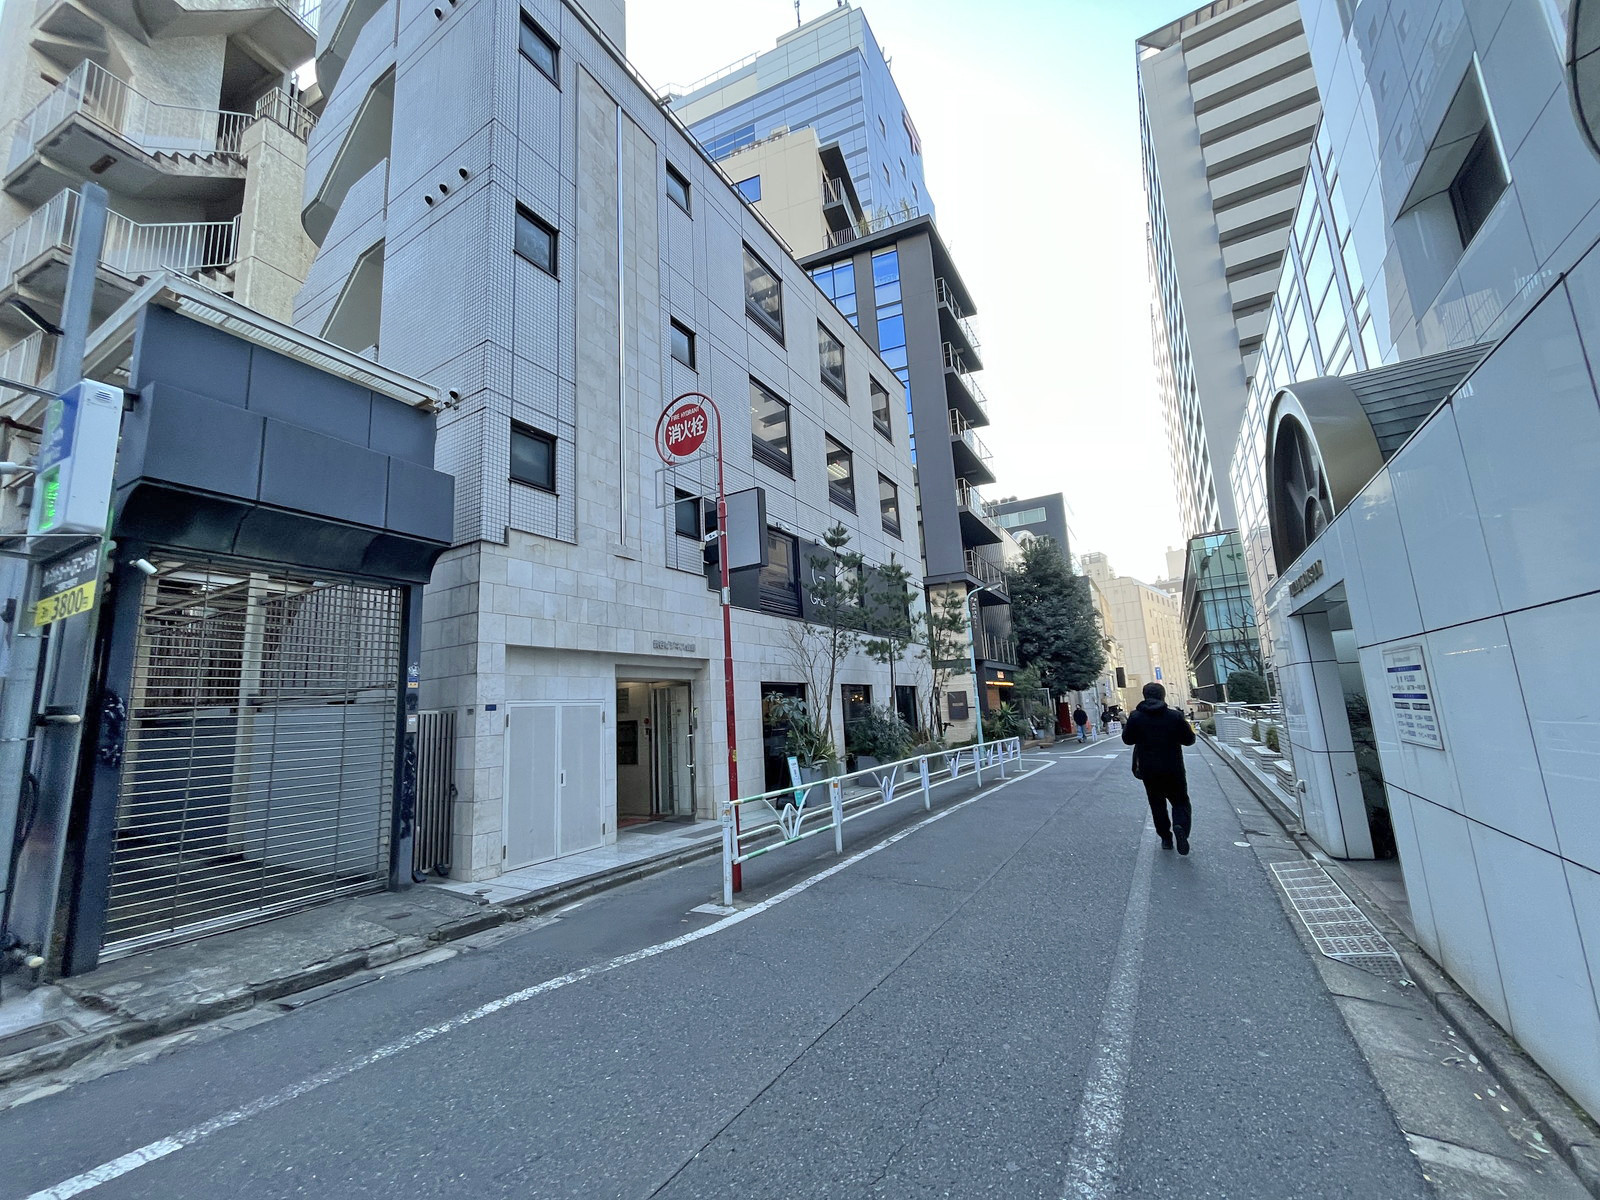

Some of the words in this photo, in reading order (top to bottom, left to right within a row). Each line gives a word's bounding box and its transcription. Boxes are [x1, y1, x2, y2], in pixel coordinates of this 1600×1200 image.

[670, 413, 680, 422] FIRE
[680, 406, 700, 419] HYDRANT
[668, 414, 705, 446] 消火栓
